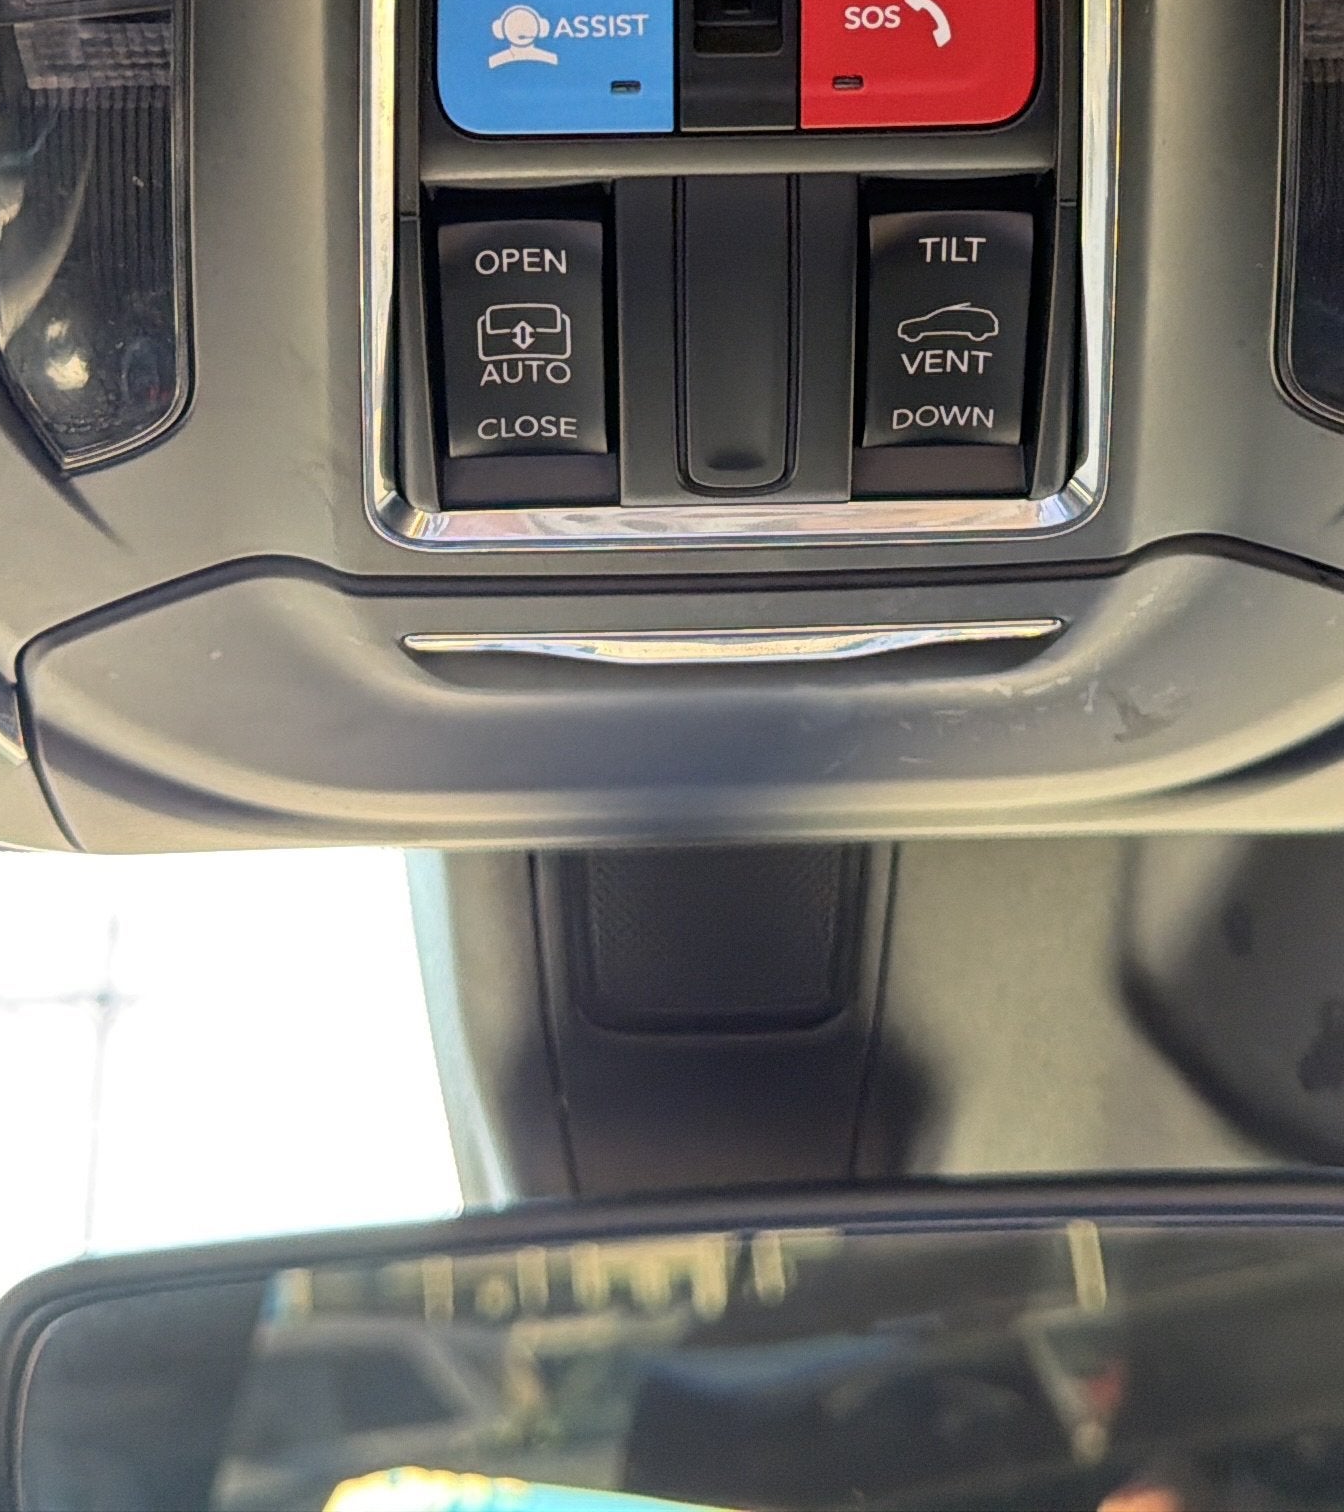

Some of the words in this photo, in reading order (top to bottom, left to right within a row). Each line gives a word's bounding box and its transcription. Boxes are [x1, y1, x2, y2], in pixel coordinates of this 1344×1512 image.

[554, 13, 649, 39] ASSIST
[844, 5, 902, 30] SOS
[475, 248, 568, 275] OPEN
[918, 236, 987, 263] TILT
[479, 360, 571, 387] AUTO
[900, 349, 993, 375] VENT
[476, 415, 578, 440] CLOSE
[891, 405, 995, 430] DOWN
